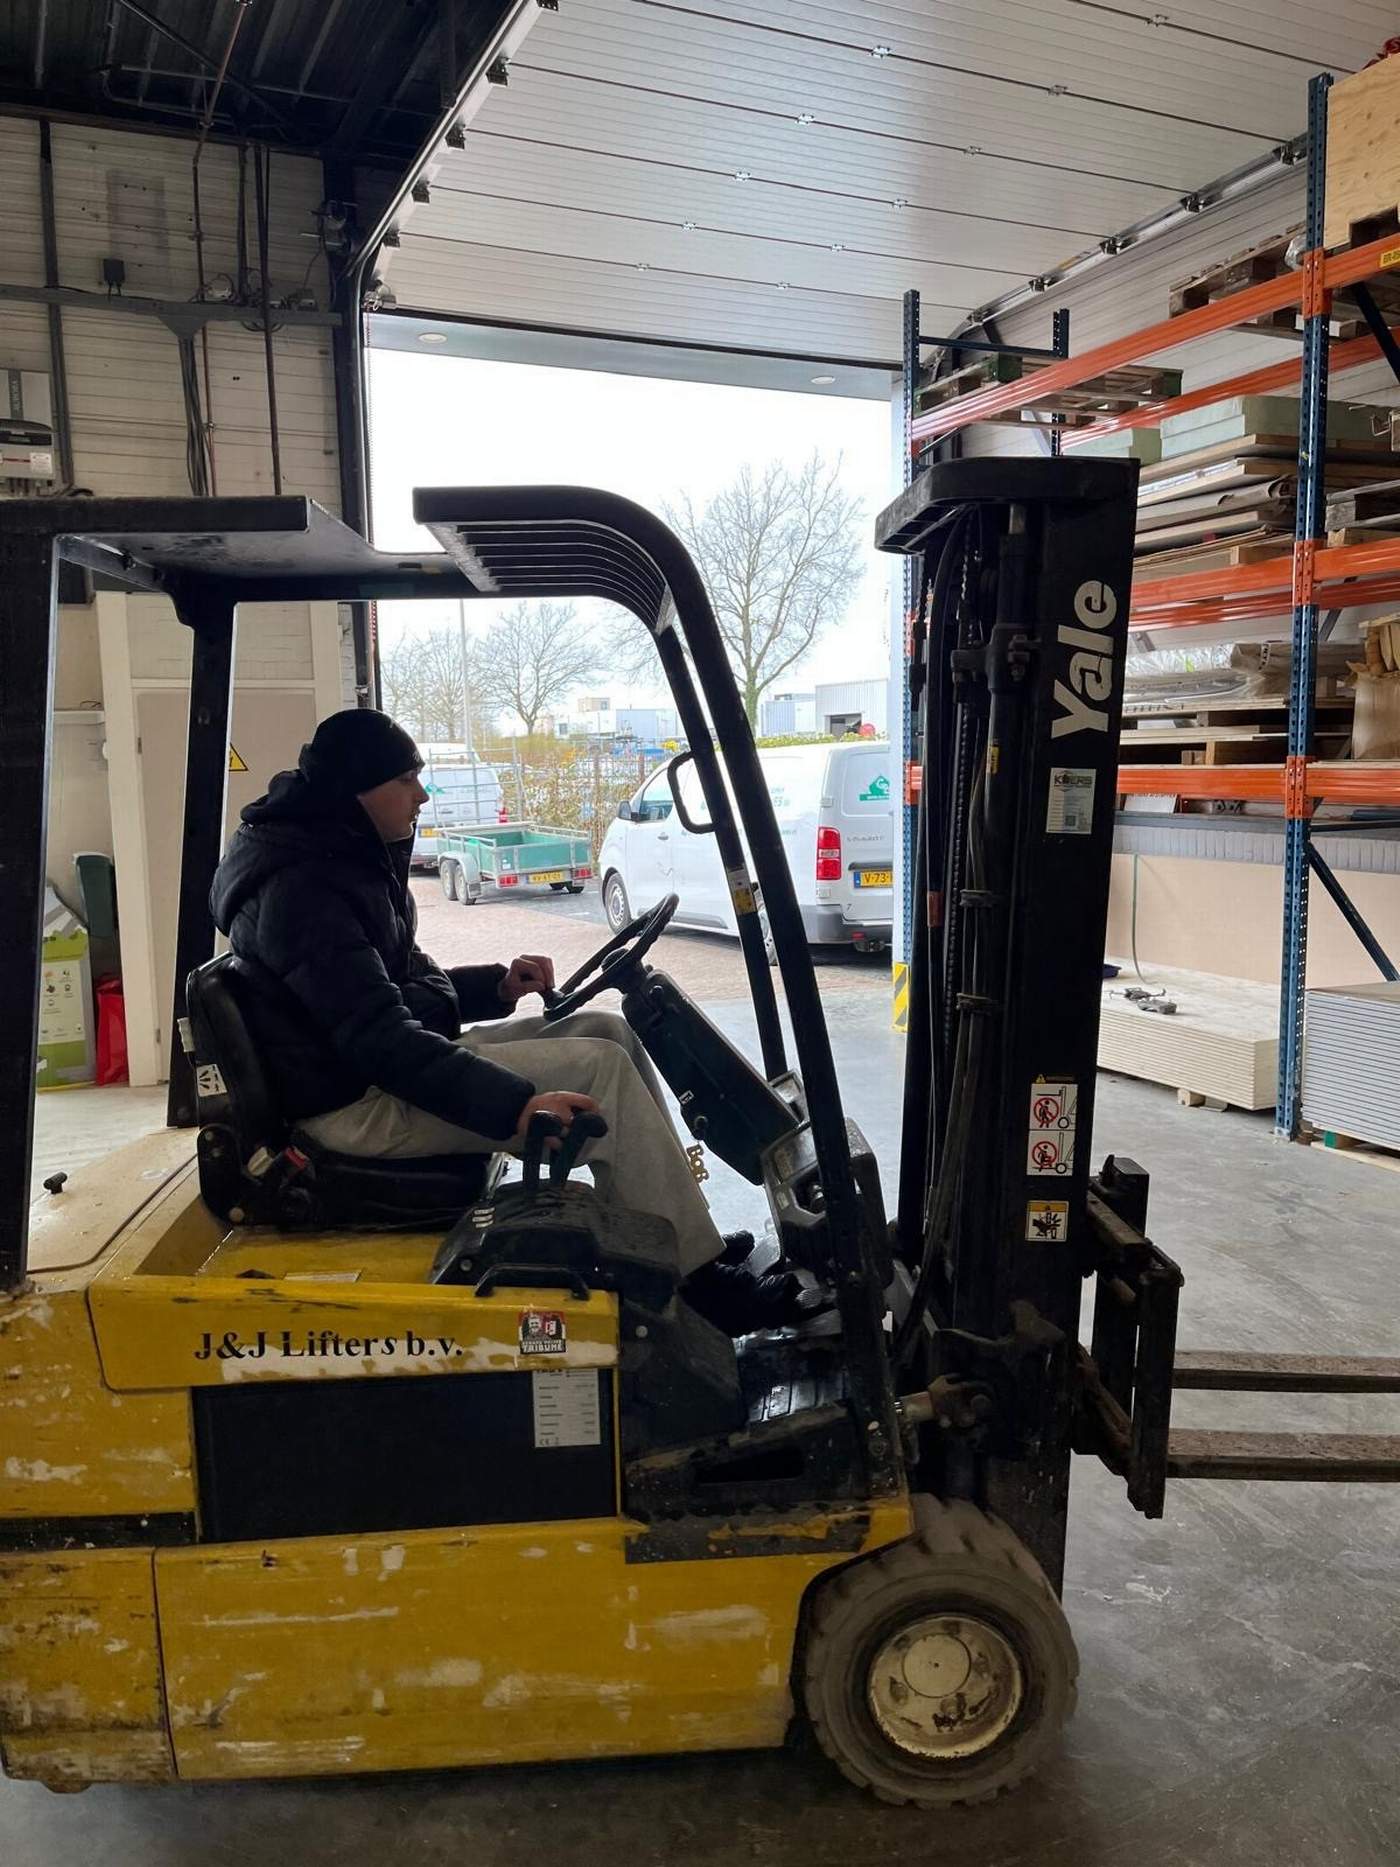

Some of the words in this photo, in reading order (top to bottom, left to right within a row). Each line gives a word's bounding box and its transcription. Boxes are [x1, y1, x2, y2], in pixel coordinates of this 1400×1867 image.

[1051, 580, 1118, 739] Yale
[194, 1331, 267, 1360] J&J
[280, 1330, 398, 1357] Lifters
[407, 1330, 463, 1356] b.v.
